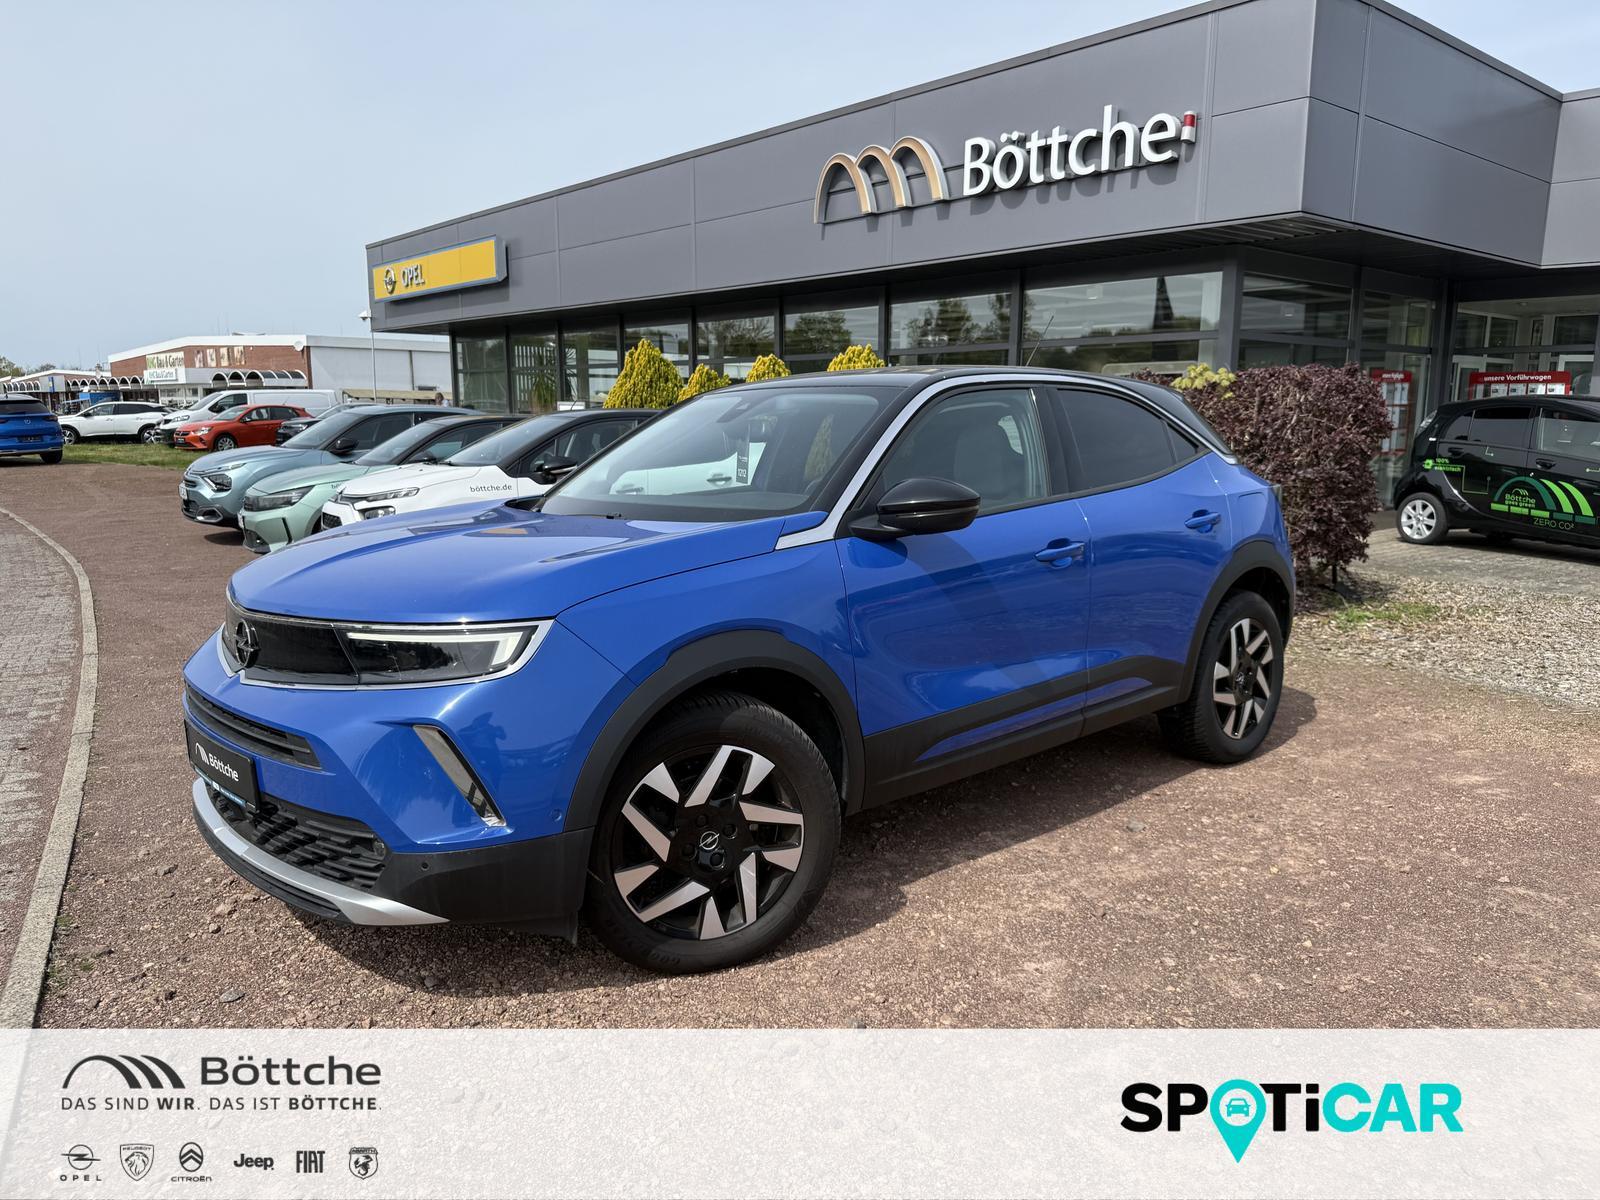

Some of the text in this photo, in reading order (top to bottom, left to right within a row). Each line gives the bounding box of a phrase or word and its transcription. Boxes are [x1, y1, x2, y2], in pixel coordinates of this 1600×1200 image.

[401, 264, 425, 287] OPEL
[1506, 374, 1552, 382] Vorführwagen
[470, 483, 513, 493] böttche.de
[1505, 493, 1536, 504] Böttche
[1533, 517, 1557, 528] ZERO
[208, 753, 239, 782] Böttche
